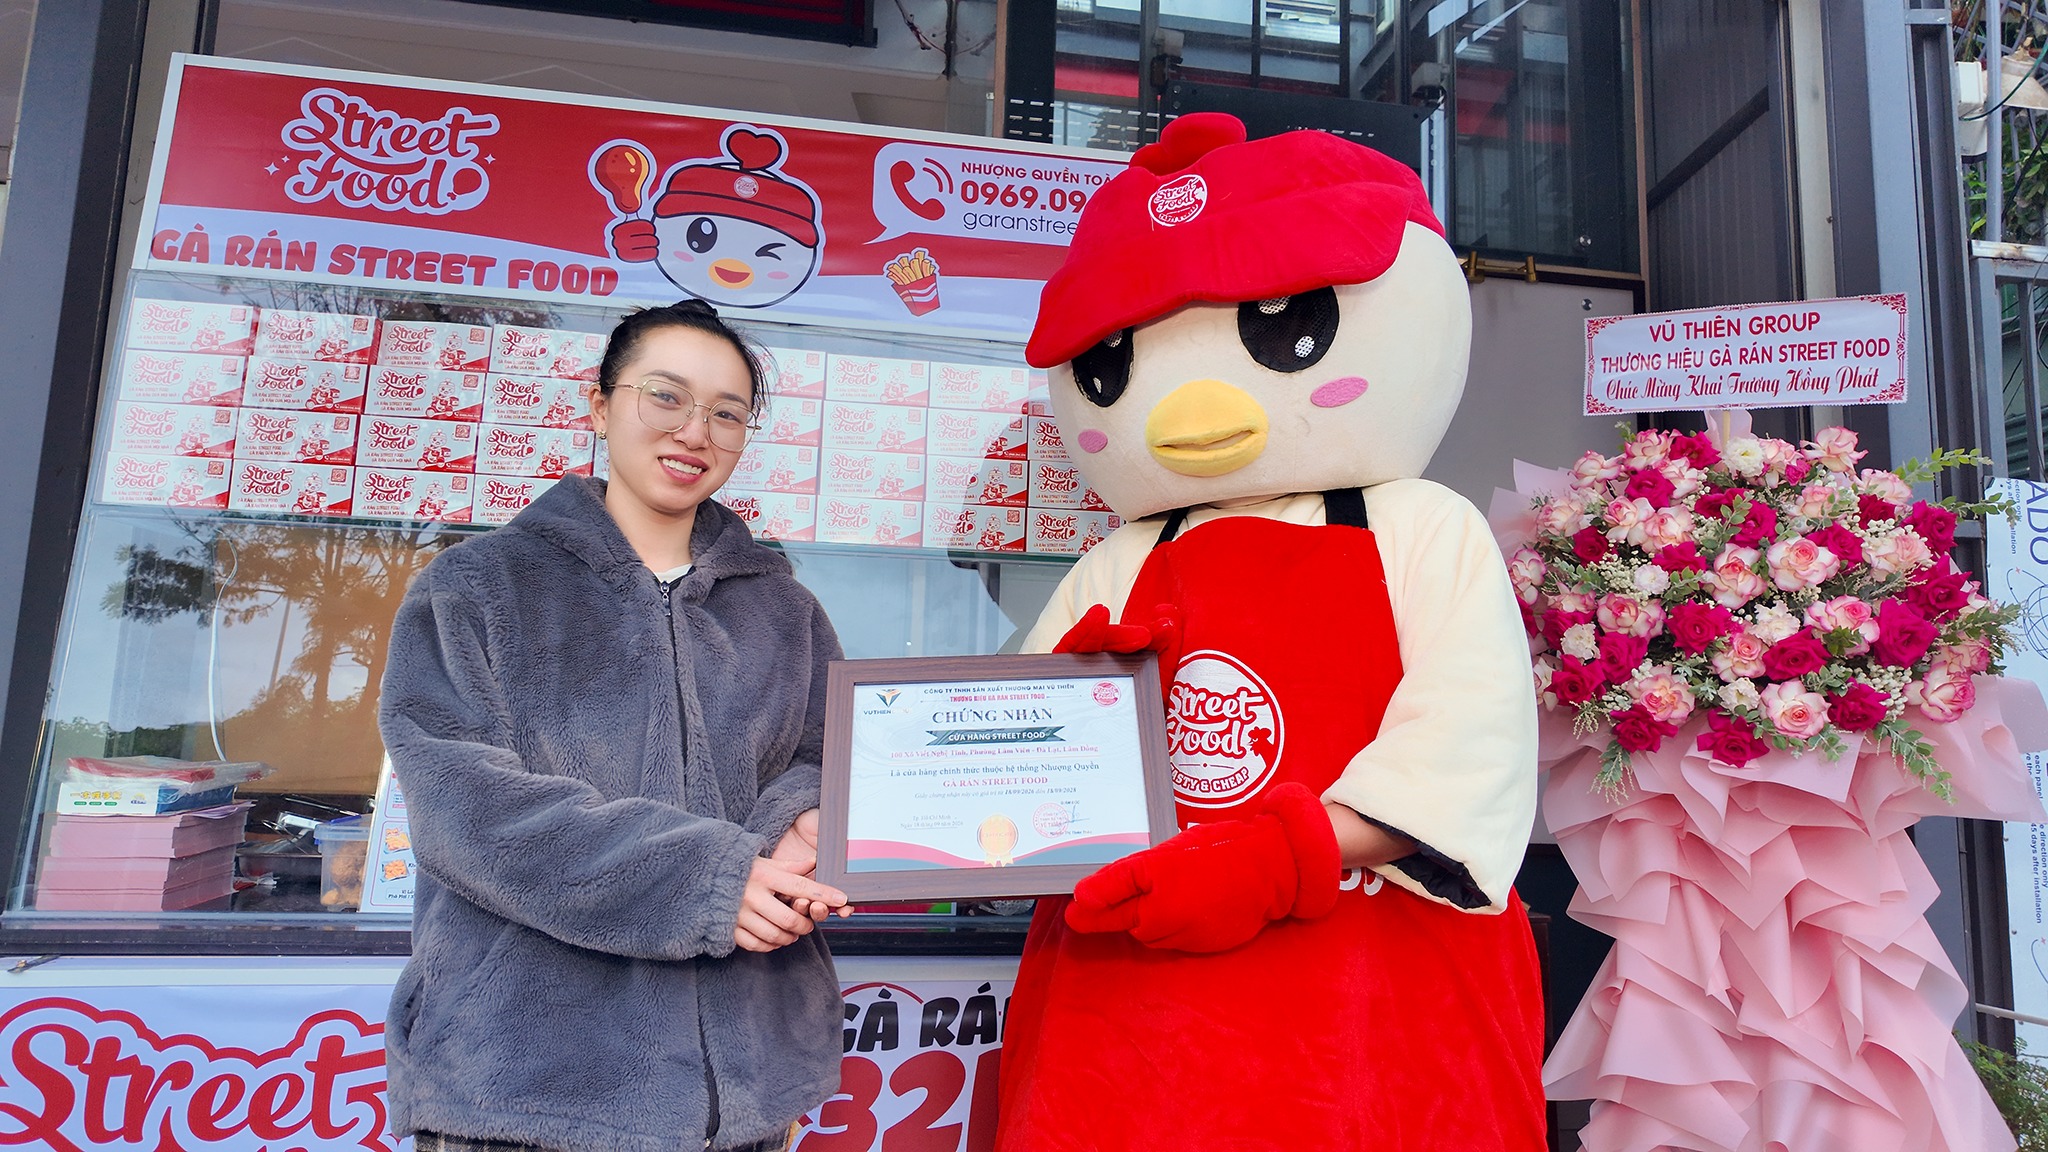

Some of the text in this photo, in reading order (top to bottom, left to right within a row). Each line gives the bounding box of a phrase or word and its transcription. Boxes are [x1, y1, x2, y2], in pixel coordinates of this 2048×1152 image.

[286, 92, 496, 158] Street
[291, 148, 450, 209] Food
[961, 162, 1027, 179] NHƯỢNG
[1031, 168, 1079, 184] QUYỀN
[960, 180, 1086, 213] 0969.09
[1154, 177, 1199, 203] Street
[1157, 191, 1195, 212] Food
[150, 224, 618, 296] GÀ RÁN STREET FOOD
[142, 305, 192, 323] Street
[144, 319, 182, 333] Food
[266, 313, 317, 330] Street
[1649, 312, 1820, 342] VŨ THIÊN GROUP
[268, 328, 305, 341] Food
[389, 326, 435, 341] Street
[502, 330, 549, 346] Street
[390, 339, 425, 352] Food
[504, 343, 539, 357] Food
[1601, 338, 1890, 374] THƯƠNG HIỆU GÀ RÁN STREET FOOD
[135, 356, 184, 373] Street
[258, 362, 308, 380] Street
[838, 360, 878, 374] Street
[136, 370, 174, 384] Food
[379, 371, 427, 387] Street
[839, 372, 870, 385] Food
[939, 368, 980, 381] Street
[259, 376, 297, 390] Food
[495, 379, 543, 395] Street
[941, 380, 972, 392] Food
[1606, 365, 1879, 401] Chúc Mừng Khai Trương Hồng Phát
[380, 384, 415, 398] Food
[496, 392, 533, 406] Food
[125, 407, 176, 425] Street
[833, 406, 875, 421] Street
[248, 414, 297, 431] Street
[834, 419, 866, 432] Food
[937, 414, 977, 428] Street
[127, 422, 165, 436] Food
[249, 429, 286, 443] Food
[369, 421, 418, 438] Street
[938, 427, 970, 439] Food
[371, 435, 408, 449] Food
[488, 429, 535, 446] Street
[489, 443, 526, 457] Food
[116, 458, 168, 475] Street
[831, 454, 873, 468] Street
[242, 466, 293, 483] Street
[832, 467, 865, 480] Food
[937, 462, 977, 475] Street
[1038, 466, 1078, 480] Street
[118, 472, 157, 487] Food
[364, 474, 414, 490] Street
[938, 474, 969, 487] Food
[1040, 478, 1071, 491] Food
[244, 480, 281, 495] Food
[484, 481, 533, 497] Street
[365, 488, 403, 502] Food
[485, 495, 522, 509] Food
[827, 502, 870, 516] Street
[932, 509, 975, 522] Street
[829, 514, 860, 527] Food
[933, 521, 968, 534] Food
[1035, 514, 1077, 528] Street
[1036, 526, 1068, 539] Food
[932, 708, 1052, 723] CHỨNG NHẬN
[948, 730, 1045, 741] CỬA HÀNG STREET FOOD
[943, 776, 1048, 788] GÀ RÁN STREET FOOD
[1200, 779, 1210, 791] &
[1213, 767, 1249, 791] CHEAP
[919, 982, 1012, 1048] RÁ
[0, 1024, 386, 1146] Street
